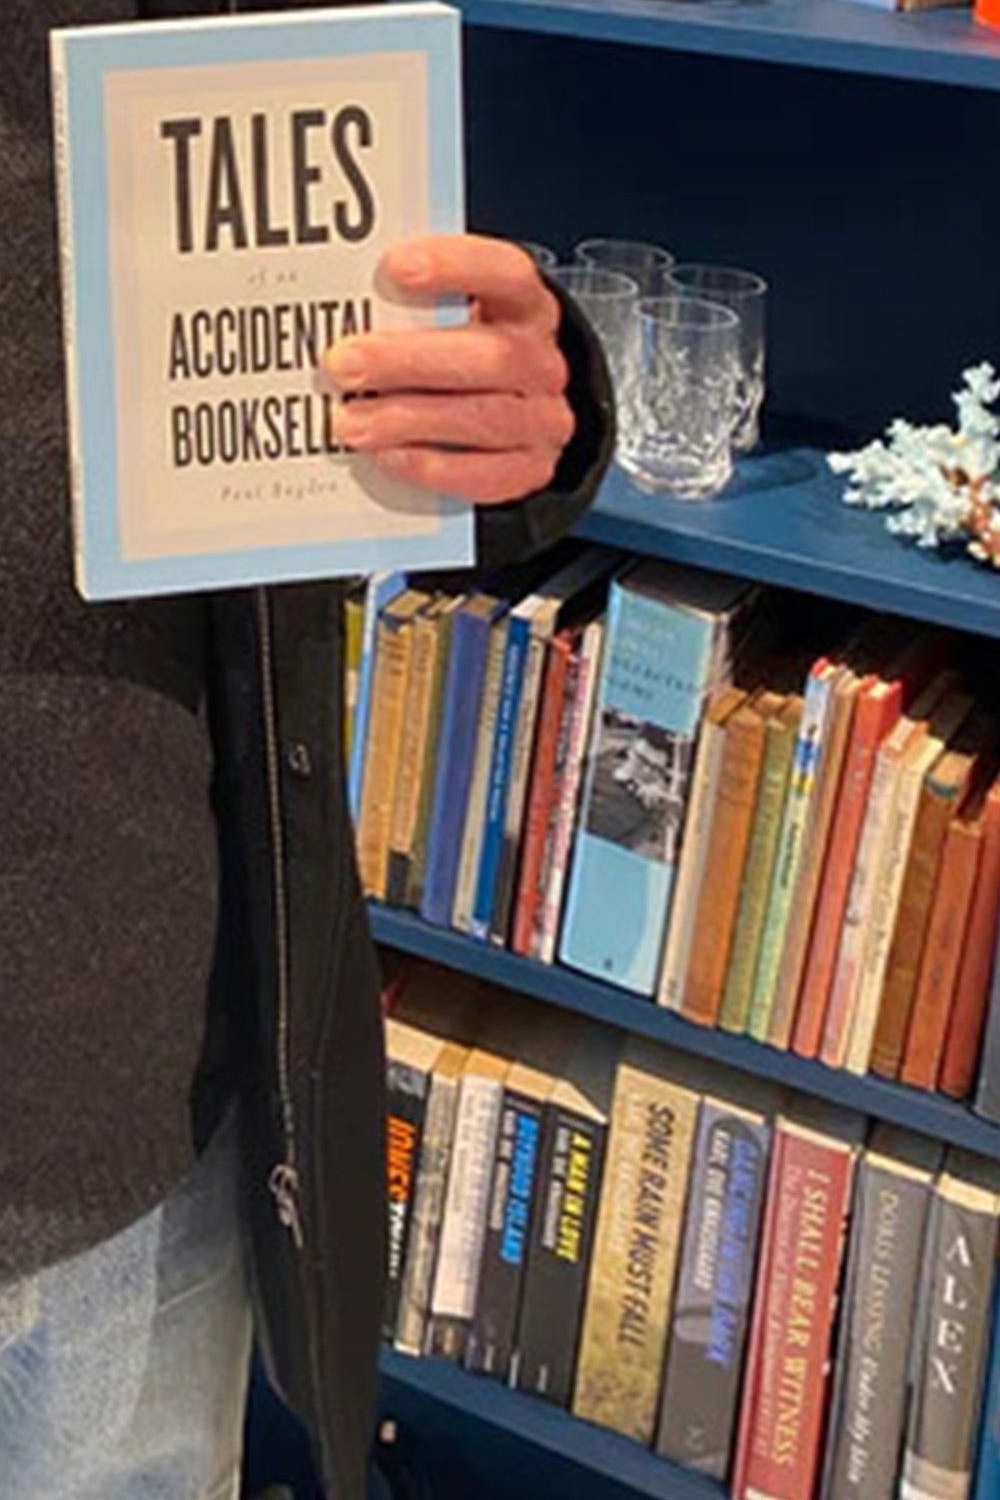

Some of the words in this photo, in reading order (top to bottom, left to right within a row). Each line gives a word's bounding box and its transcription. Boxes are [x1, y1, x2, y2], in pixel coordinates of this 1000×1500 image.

[161, 106, 376, 253] TALES
[172, 389, 379, 469] BOOKSELL
[573, 1132, 593, 1147] A
[646, 1102, 675, 1166] SOME
[566, 1149, 590, 1192] MAN
[635, 1169, 665, 1226] RAIN
[626, 1229, 656, 1296] MUST
[797, 1185, 827, 1273] SHALL
[618, 1293, 646, 1347] FALL
[786, 1276, 817, 1346] BEAR
[771, 1356, 808, 1467] WITNESS
